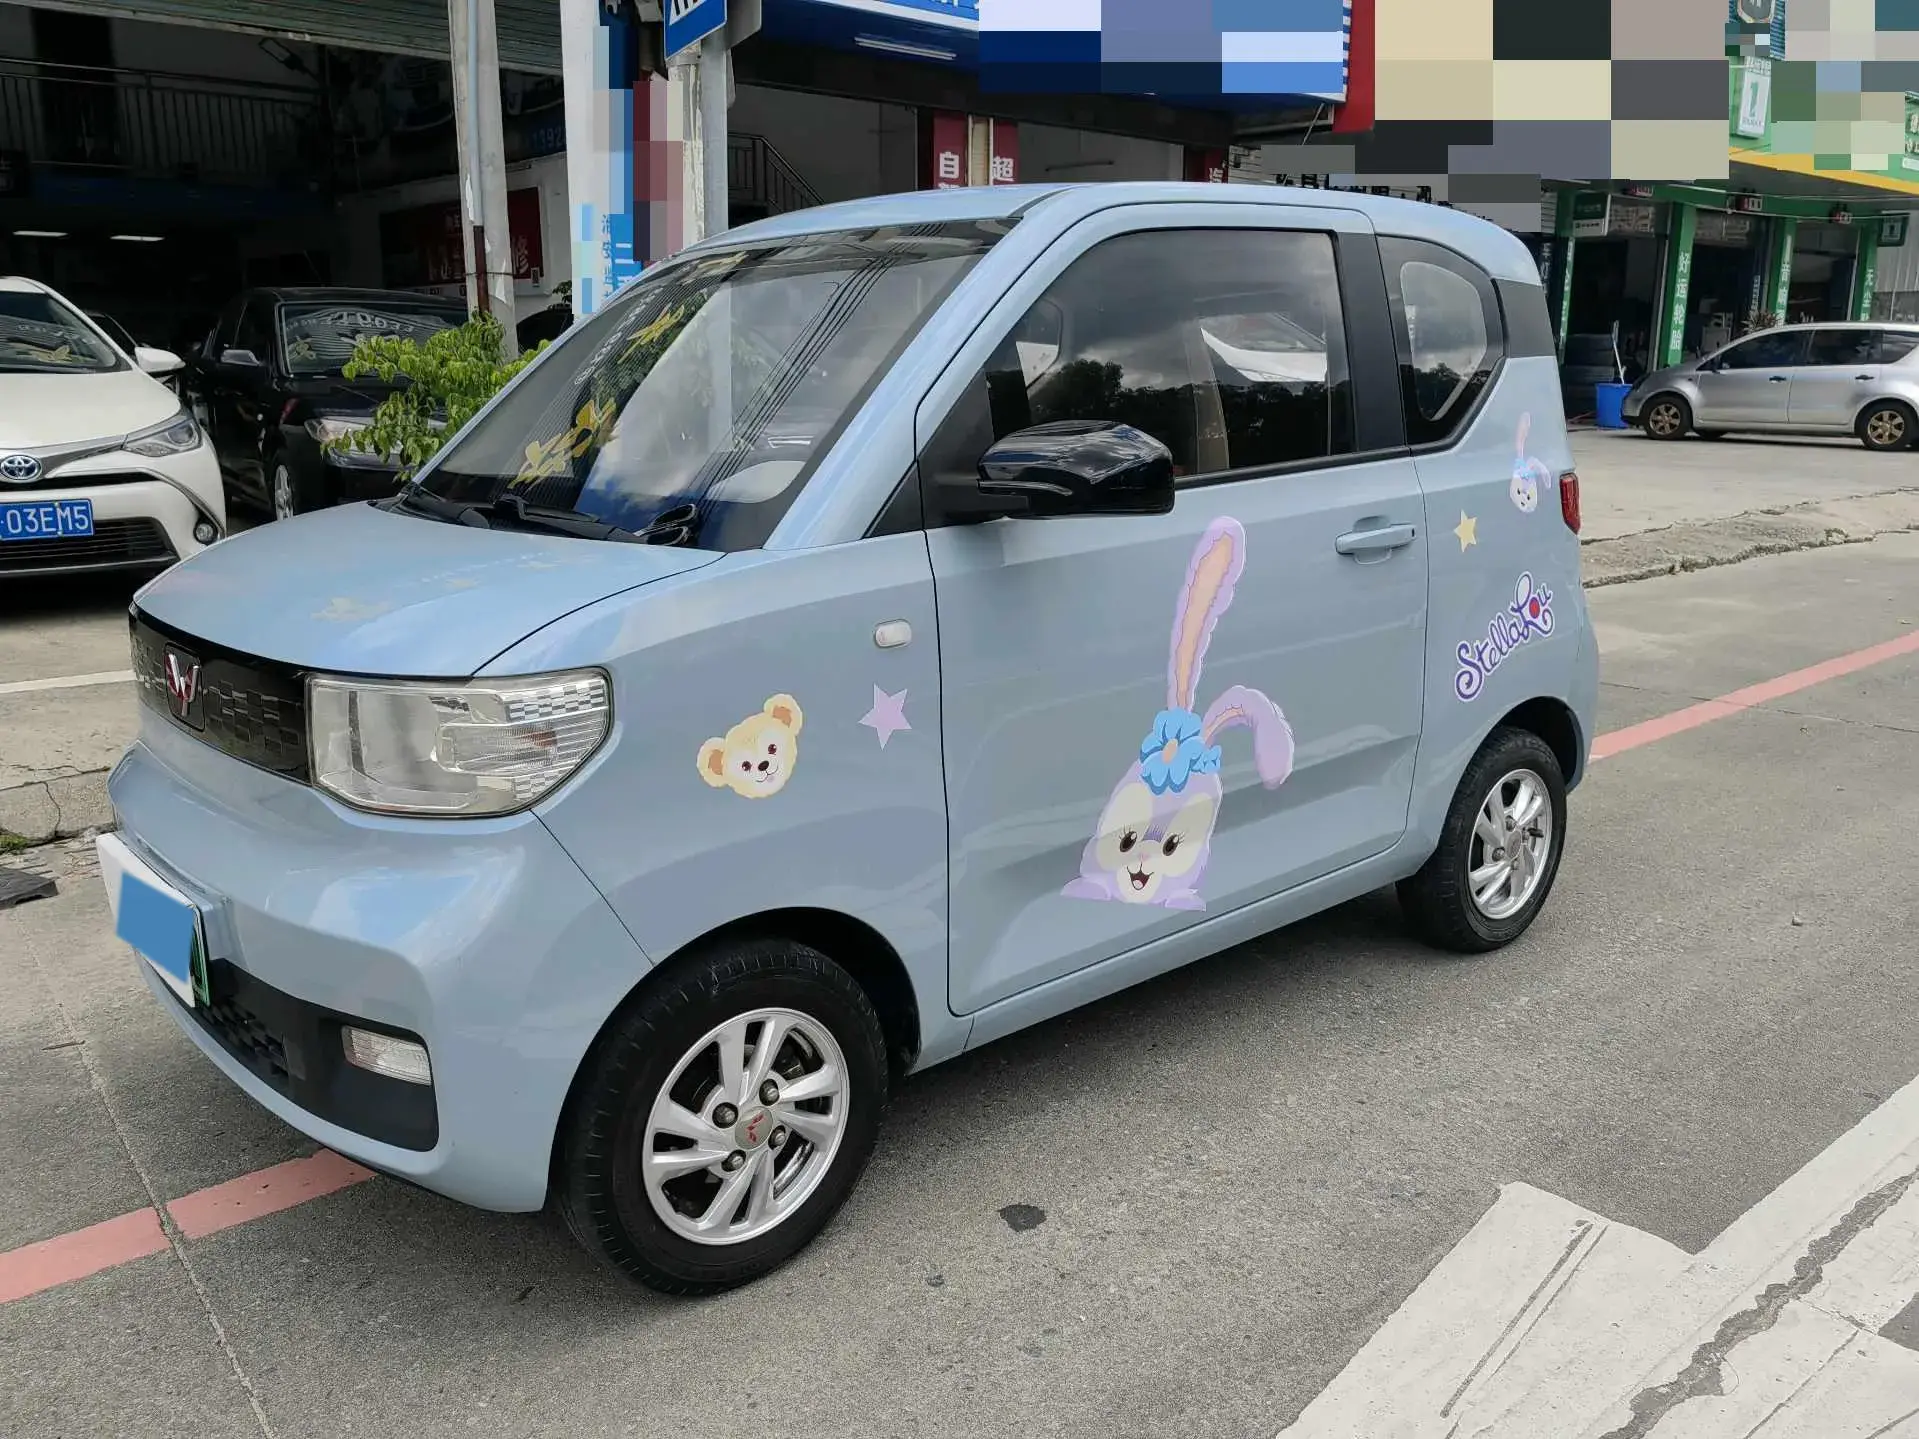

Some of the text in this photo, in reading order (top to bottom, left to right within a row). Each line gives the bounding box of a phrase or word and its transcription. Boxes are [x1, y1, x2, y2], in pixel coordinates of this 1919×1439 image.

[532, 127, 565, 149] 1392
[938, 151, 961, 188] 自
[1669, 252, 1691, 350] 好运轮胎
[6, 506, 89, 534] 03EM5
